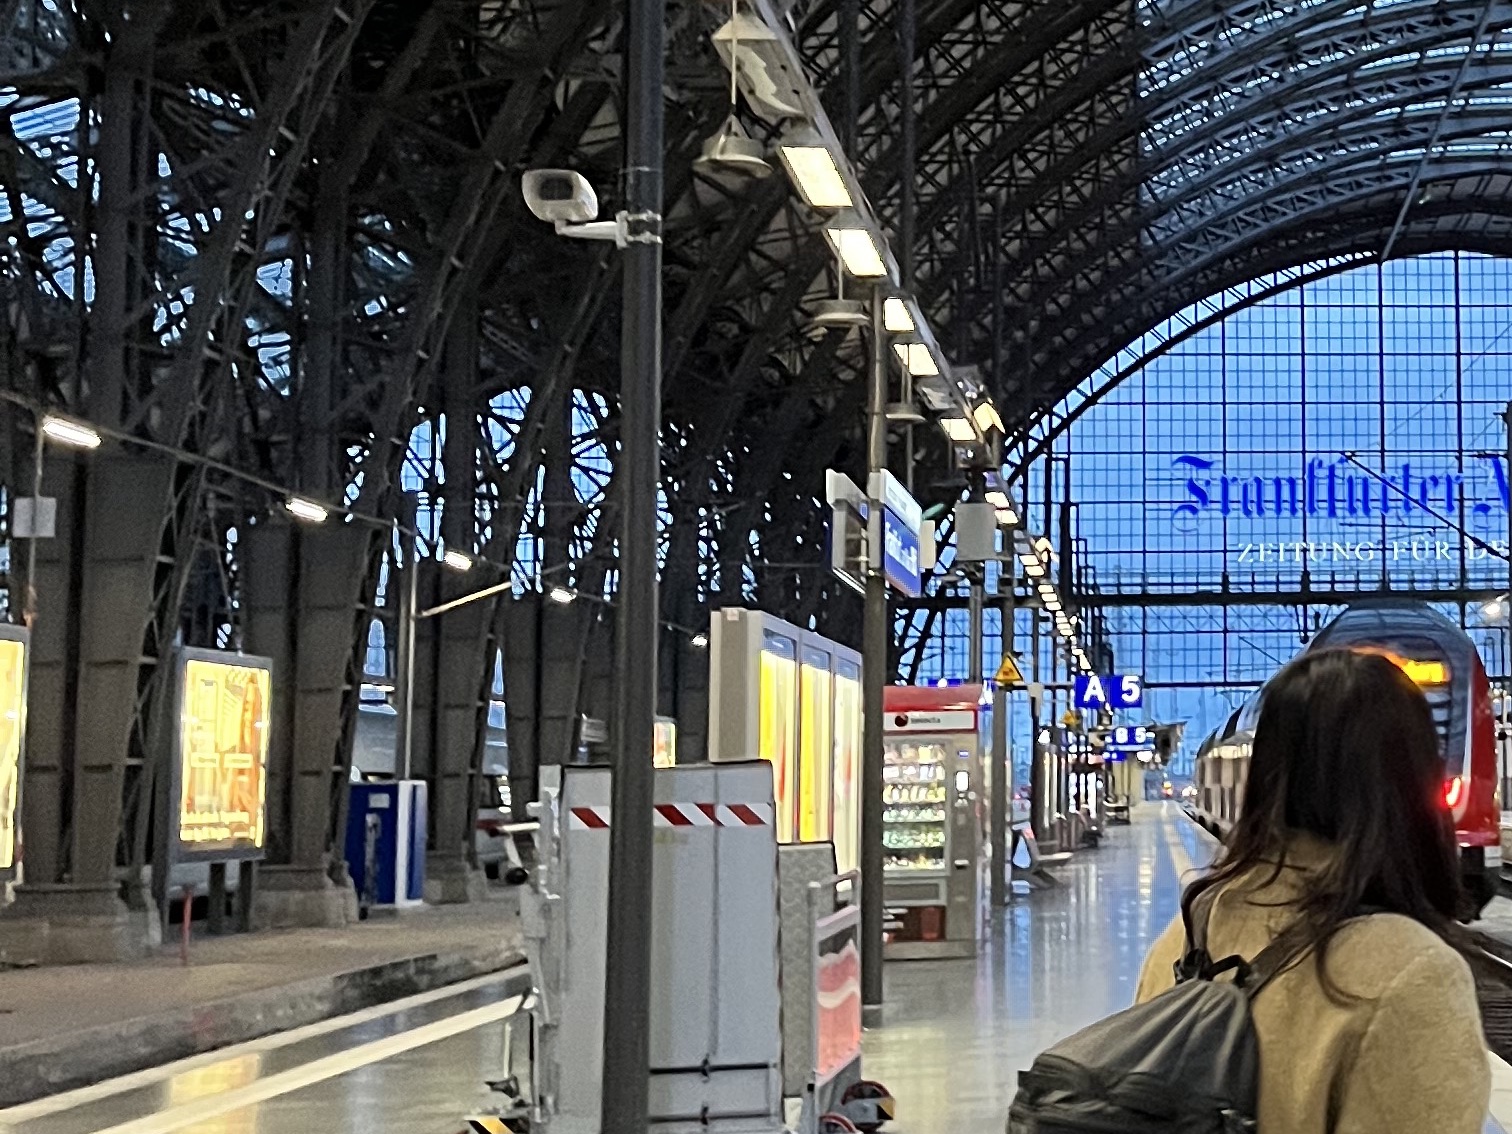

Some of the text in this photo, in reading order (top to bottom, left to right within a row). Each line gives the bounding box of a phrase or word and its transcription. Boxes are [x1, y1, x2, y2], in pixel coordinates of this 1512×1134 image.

[1171, 455, 1464, 532] Frankfurter
[1237, 541, 1374, 563] ZEITUNG
[1393, 536, 1452, 561] FÜR
[1083, 675, 1141, 702] A 5
